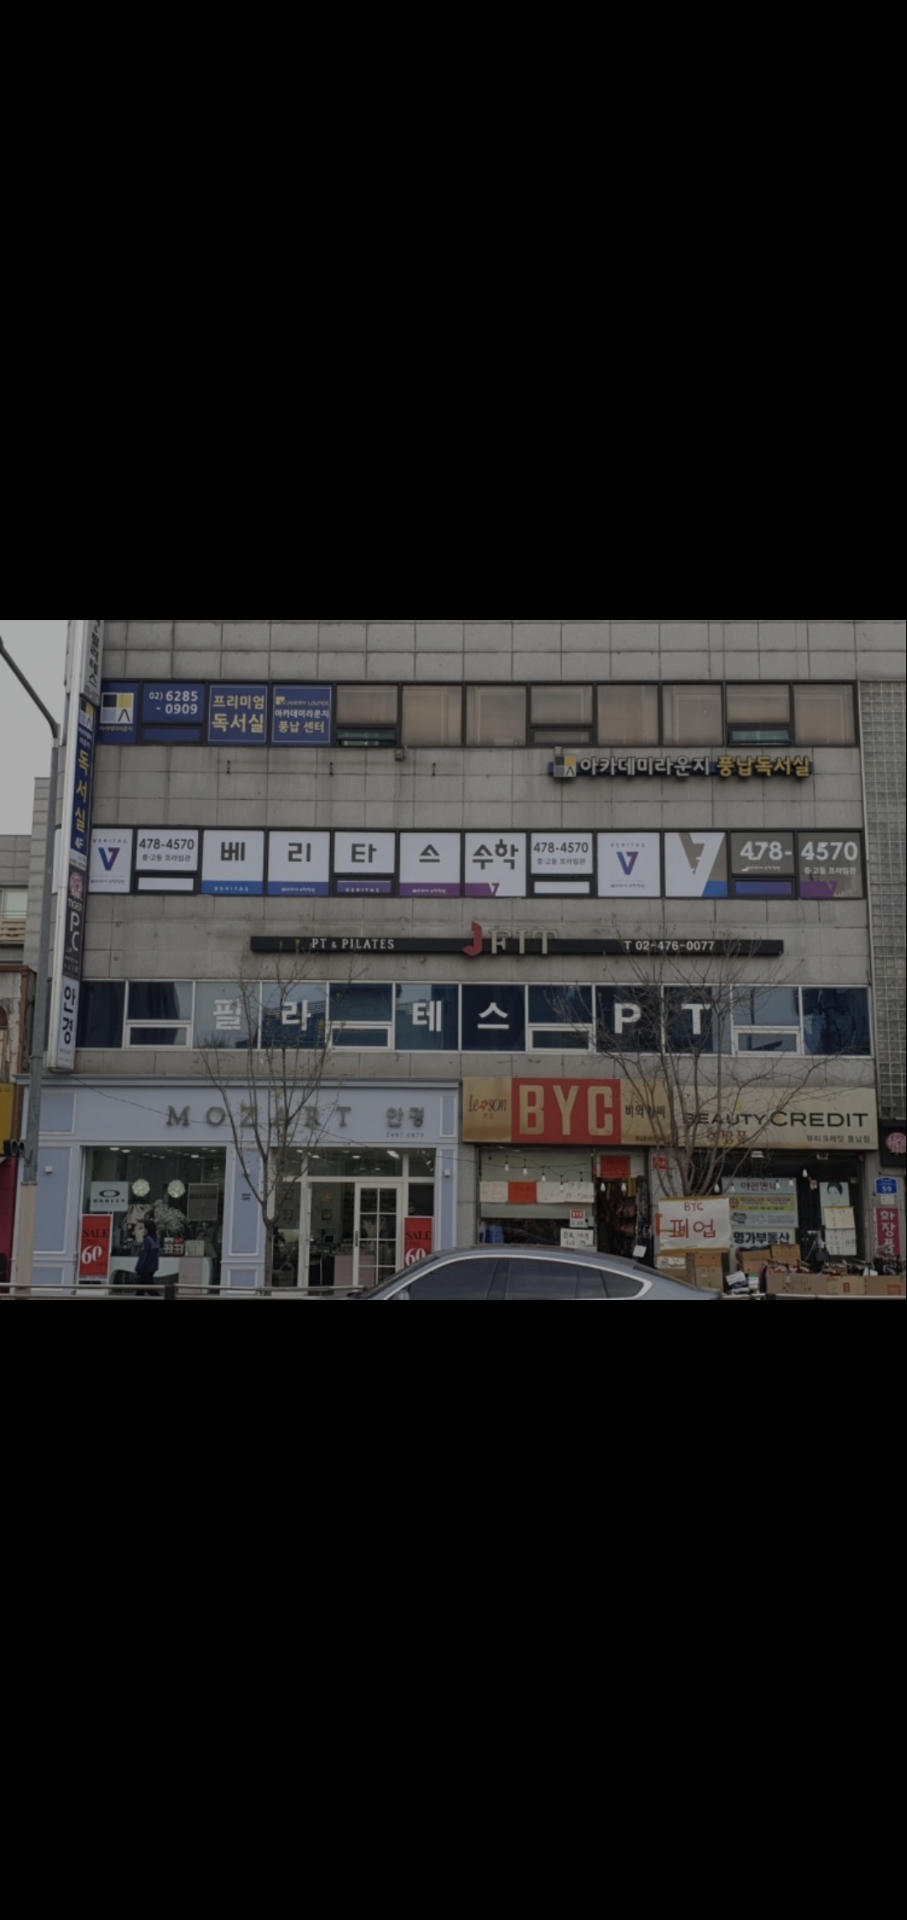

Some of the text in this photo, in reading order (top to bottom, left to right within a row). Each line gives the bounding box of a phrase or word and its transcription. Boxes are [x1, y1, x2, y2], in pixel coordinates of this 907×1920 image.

[165, 691, 198, 701] 6285
[212, 695, 265, 709] 프리미엄
[165, 704, 198, 714] 0909
[274, 709, 329, 718] 아카데미라운지
[211, 713, 265, 733] 독서실
[278, 721, 324, 733] 풍납 센터
[580, 756, 810, 777] 아카데미라운지 풍납독서실
[74, 749, 90, 833] 독서실
[139, 838, 194, 850] 478-4570
[533, 842, 589, 853] 478-4570
[472, 838, 519, 870] 수학
[311, 938, 327, 949] PT
[341, 938, 395, 949] PILATES
[635, 940, 716, 951] 02-476-0077
[62, 986, 76, 1046] 안경
[519, 1084, 614, 1136] BYC
[166, 1105, 352, 1128] MOZART
[881, 1185, 893, 1193] 59
[684, 1202, 705, 1212] BYC
[83, 1228, 109, 1238] SALE
[405, 1230, 432, 1240] SALE
[733, 1231, 791, 1245] 명가부동산
[81, 1245, 103, 1265] 60
